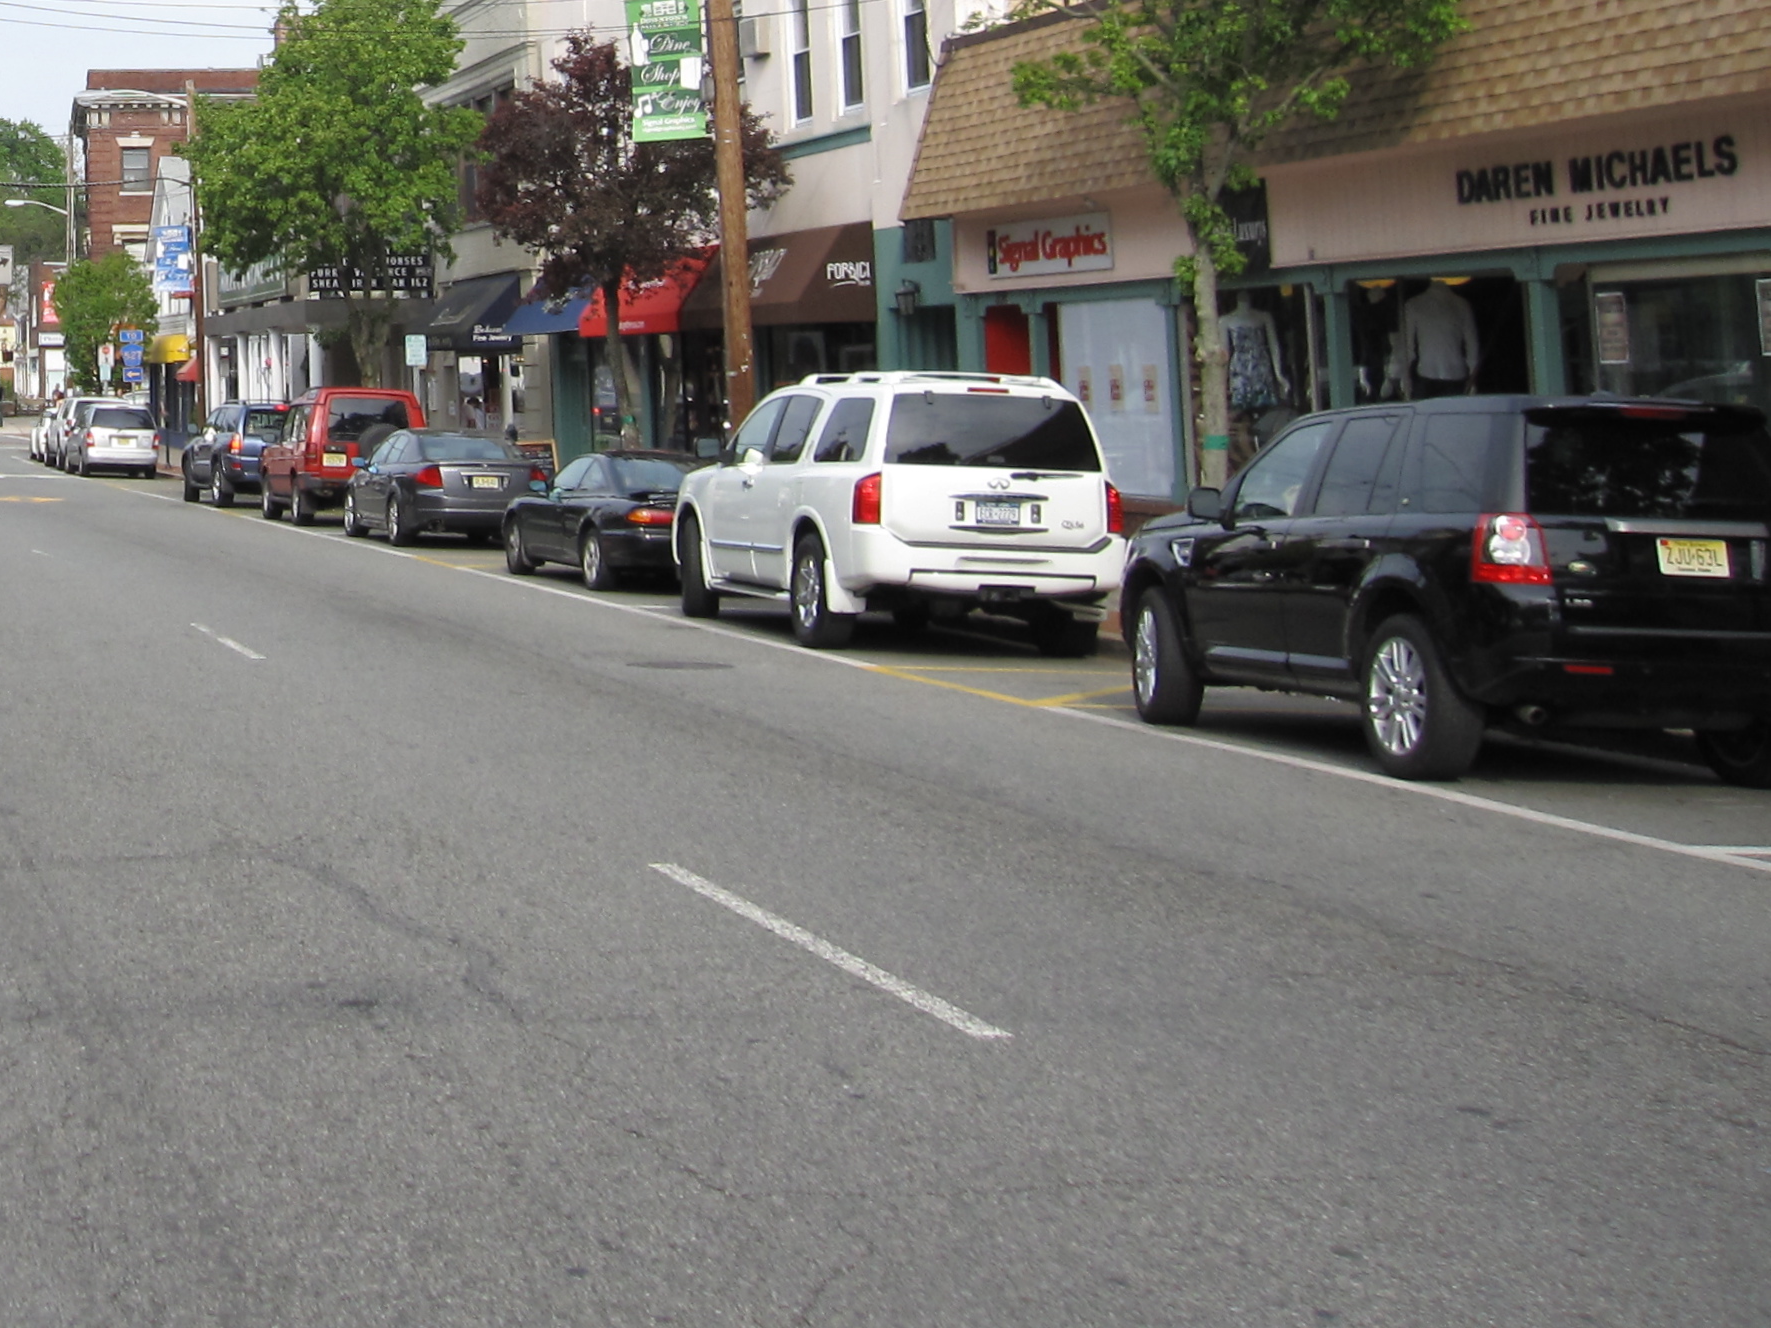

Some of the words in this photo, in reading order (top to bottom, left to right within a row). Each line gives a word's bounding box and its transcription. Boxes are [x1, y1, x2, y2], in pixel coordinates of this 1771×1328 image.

[649, 33, 691, 54] Dine
[640, 62, 680, 87] Shop
[657, 91, 702, 115] Enjoy
[1456, 160, 1554, 205] DAREN
[1568, 134, 1739, 194] MICHAELS
[1530, 206, 1574, 226] FINE
[1584, 196, 1671, 222] JEWELRY
[998, 229, 1040, 272] Signal
[1042, 224, 1108, 268] Graphics
